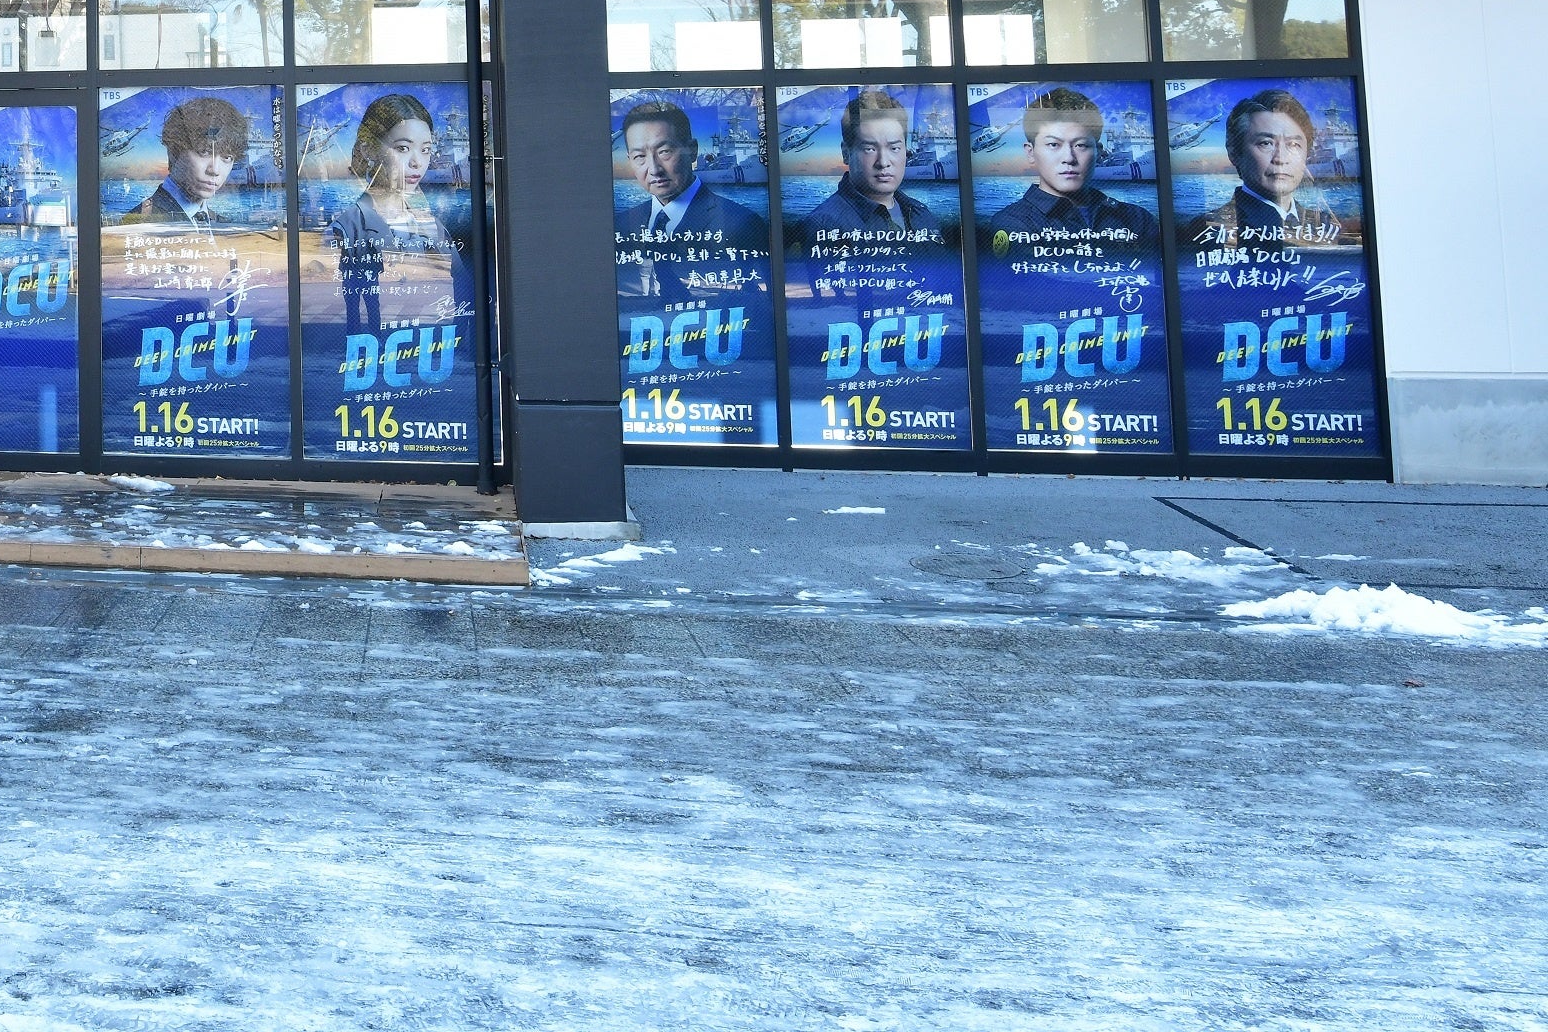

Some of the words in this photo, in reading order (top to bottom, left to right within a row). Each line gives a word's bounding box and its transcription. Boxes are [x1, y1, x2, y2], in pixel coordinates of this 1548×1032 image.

[301, 87, 319, 96] TBS
[779, 87, 798, 96] TBS
[970, 88, 988, 96] TBS
[1167, 82, 1186, 91] TBS
[103, 91, 121, 100] TBS
[665, 300, 706, 312] 日曜劇場
[863, 307, 905, 318] 日曜劇場
[1261, 305, 1306, 318] 日曜劇場
[176, 311, 216, 323] 日曜劇場
[1060, 307, 1102, 319] 日曜劇場
[380, 318, 420, 330] 日曜劇場
[628, 307, 745, 374] DCU
[825, 313, 945, 380] DCU
[1222, 312, 1348, 382] DCU
[138, 318, 253, 386] DCU
[1020, 314, 1143, 383] DCU
[343, 325, 457, 392] DCU
[622, 388, 686, 419] 1.16
[689, 404, 752, 421] START!
[133, 401, 194, 434] 1.16
[197, 418, 259, 434] START!
[821, 395, 886, 427] 1.16
[890, 411, 955, 428] START!
[1015, 398, 1085, 431] 1.16
[1088, 415, 1158, 432] START!
[1216, 397, 1288, 431] 1.16
[1292, 414, 1363, 431] START!
[335, 405, 399, 439] 1.16
[403, 422, 467, 439] START!
[822, 429, 887, 441] 日曜よる9時
[1218, 433, 1289, 446] 日曜よる9時
[134, 436, 194, 448] 日曜よる9時
[336, 441, 399, 454] 日曜よる9時
